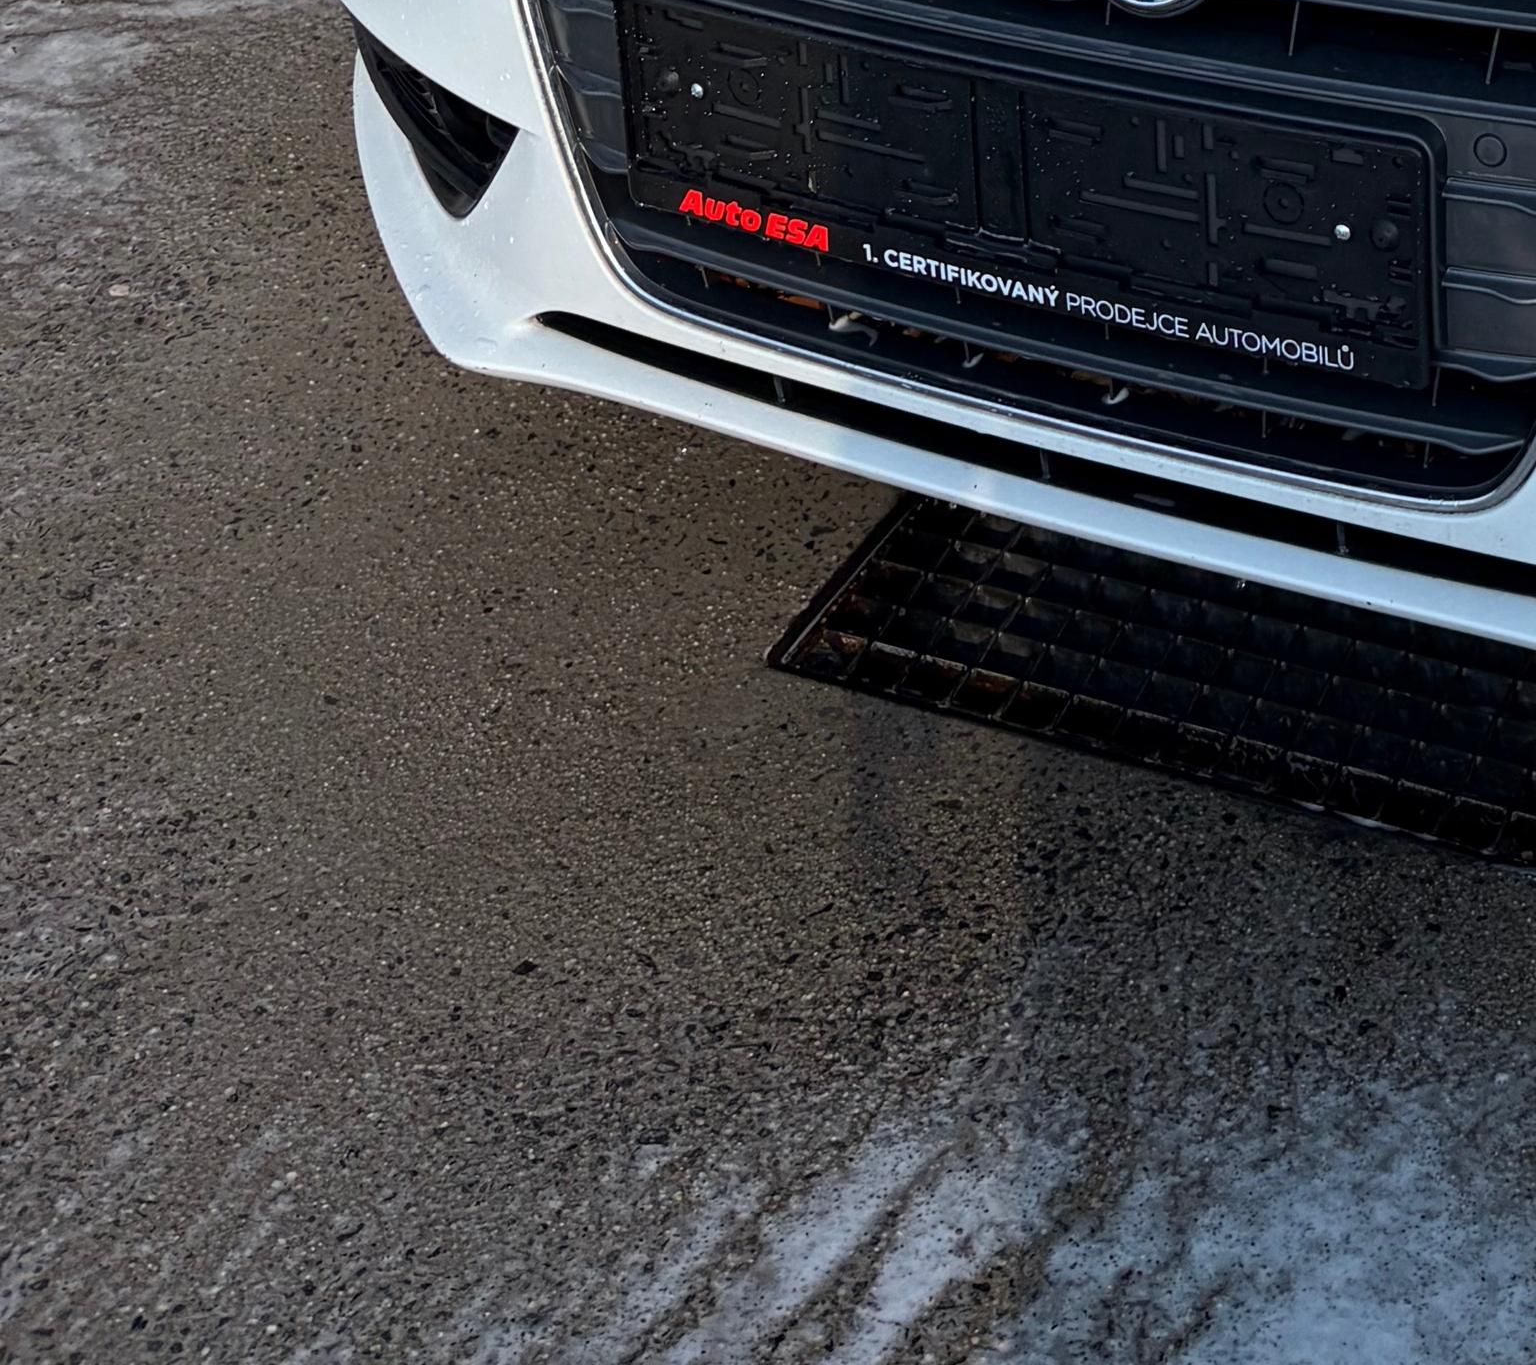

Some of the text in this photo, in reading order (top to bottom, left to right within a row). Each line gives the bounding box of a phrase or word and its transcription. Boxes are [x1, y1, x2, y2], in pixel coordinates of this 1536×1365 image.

[679, 189, 830, 253] Auto ESA
[862, 243, 1355, 370] 1. CERTIFIKOVANÝ PRODEJCE AUTOMOBILŮ
